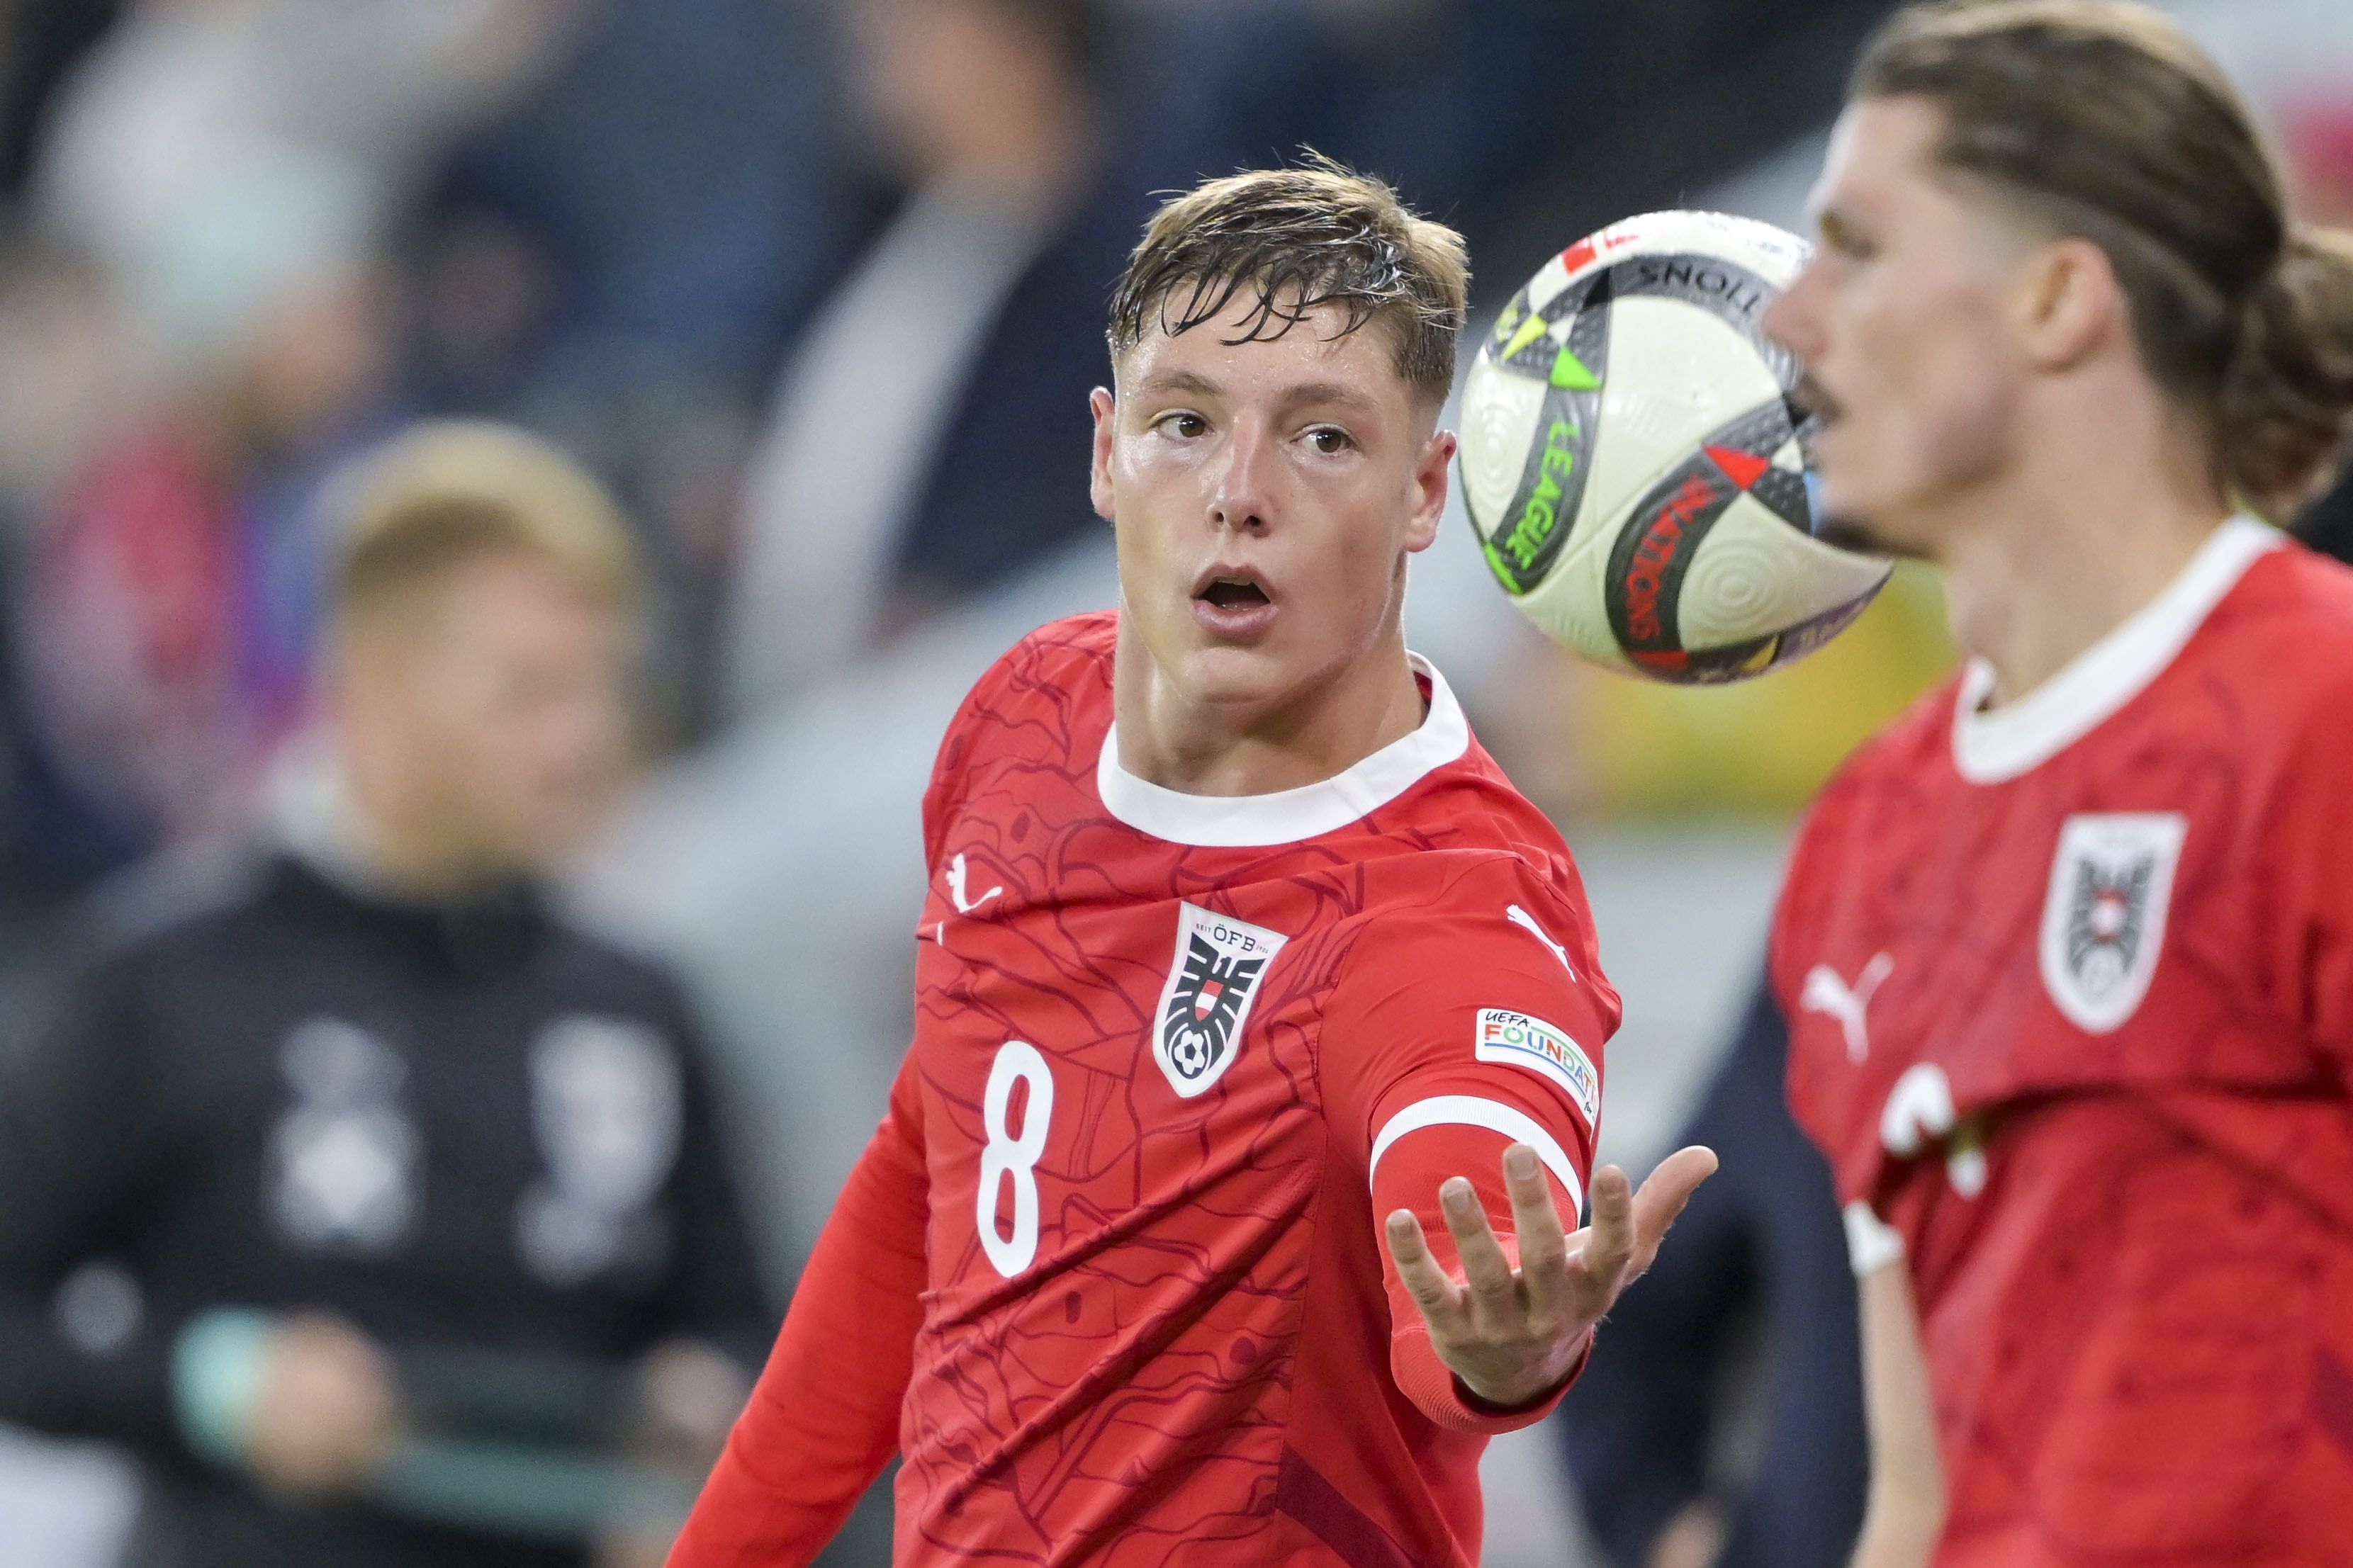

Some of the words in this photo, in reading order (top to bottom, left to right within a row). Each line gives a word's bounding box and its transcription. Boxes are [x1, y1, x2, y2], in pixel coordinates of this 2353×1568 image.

[1507, 420, 1581, 570] LEAGUE
[1624, 472, 1717, 641] NATIONS
[1196, 923, 1211, 933] SEIT
[1213, 923, 1256, 952] ÖFB
[1486, 1011, 1529, 1027] UEFA
[977, 1040, 1054, 1278] 8
